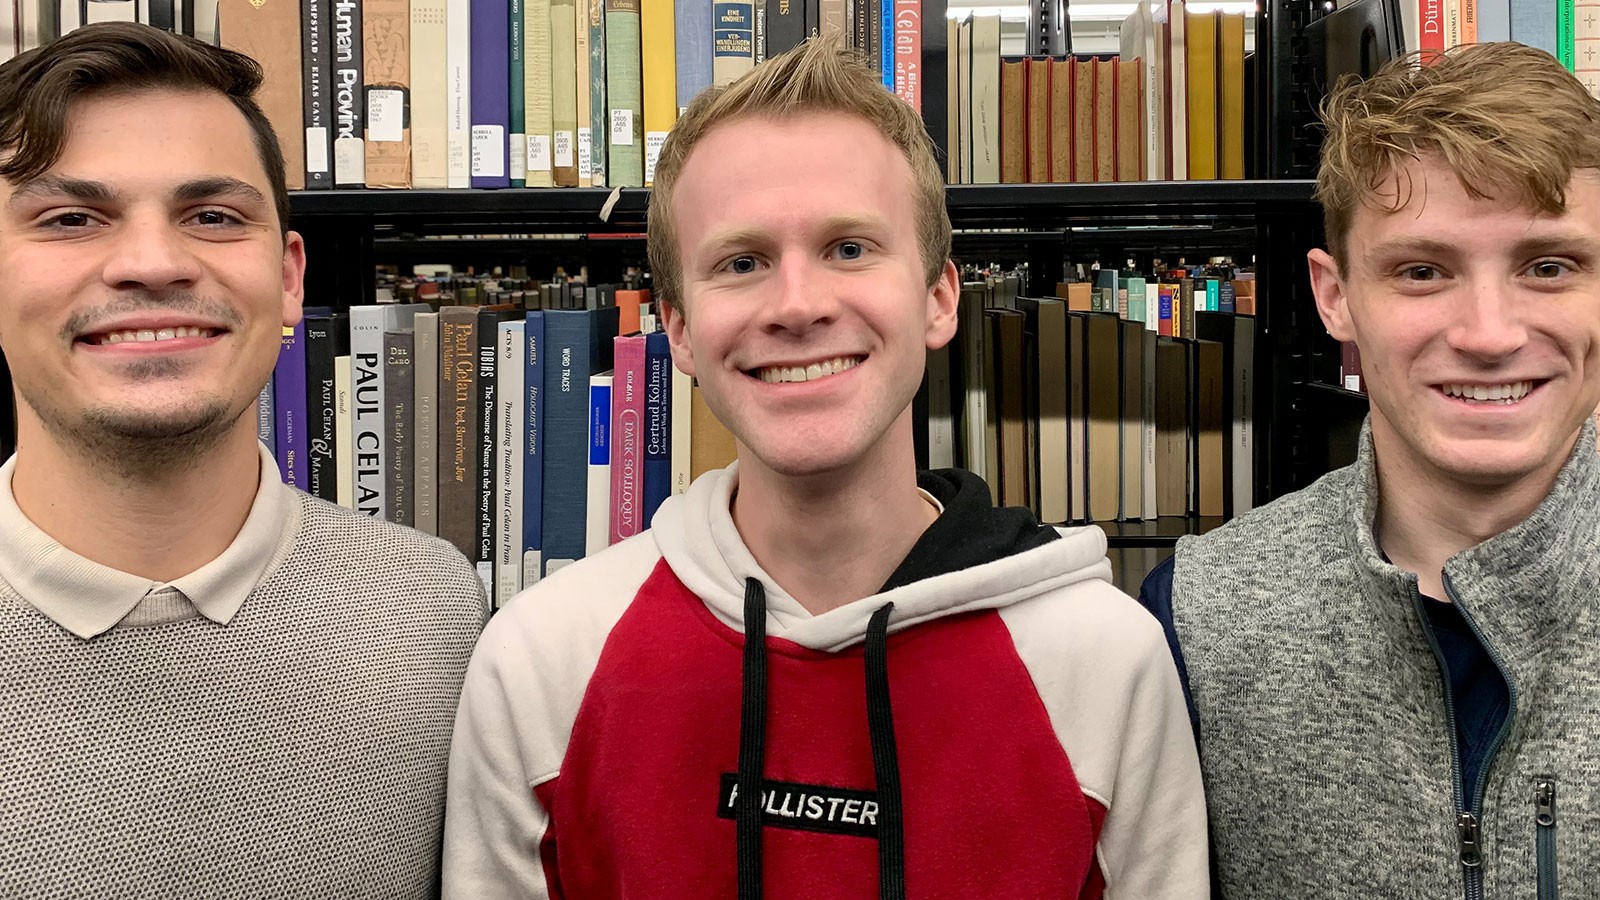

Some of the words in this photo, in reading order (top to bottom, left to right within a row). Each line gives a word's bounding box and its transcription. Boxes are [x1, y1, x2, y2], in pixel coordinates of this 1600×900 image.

[756, 9, 764, 36] Nineteen
[884, 18, 891, 27] an
[897, 9, 918, 55] Celan
[756, 36, 764, 55] Poems
[756, 55, 764, 64] by
[897, 62, 906, 75] of
[908, 62, 917, 70] A
[897, 76, 906, 95] His
[309, 329, 327, 339] Lyon
[443, 322, 453, 343] John
[456, 322, 473, 357] Paul
[388, 357, 410, 365] CARO
[390, 347, 408, 355] DEL
[480, 345, 494, 377] TOBIAS
[504, 346, 512, 359] 8/9
[561, 347, 571, 367] WORD
[356, 353, 379, 420] PAUL
[455, 360, 473, 402] Celan
[561, 368, 571, 392] TRACES
[648, 358, 660, 404] Kolmar
[660, 377, 668, 388] und
[322, 379, 333, 406] PAUL
[484, 385, 493, 400] The
[660, 388, 668, 405] Texten
[395, 402, 404, 419] The
[455, 405, 466, 425] Poet,
[529, 386, 538, 428] HOLOCAUST
[323, 407, 334, 440] CELAN
[421, 395, 429, 449] POETIC
[483, 401, 493, 434] Discourse
[503, 401, 512, 447] Translating
[660, 412, 668, 426] Werk
[394, 422, 404, 442] Early
[483, 434, 493, 443] of
[623, 421, 634, 457] DARK
[647, 406, 660, 455] Gertrud
[660, 426, 668, 438] und
[455, 426, 466, 465] Survivor,
[660, 437, 668, 454] Leben
[394, 446, 404, 471] Poetry
[482, 444, 492, 468] Nature
[288, 470, 296, 481] of
[311, 457, 321, 497] MARTIN
[454, 465, 466, 482] Jew
[482, 469, 492, 477] in
[503, 448, 512, 487] Tradition:
[395, 474, 404, 483] of
[482, 478, 491, 489] the
[395, 486, 404, 507] PAUL
[480, 490, 491, 513] Poetry
[503, 488, 512, 508] Paul
[621, 458, 634, 529] SOLILOQUY
[481, 513, 491, 522] of
[503, 509, 512, 532] Celan
[481, 522, 491, 538] Paul
[503, 534, 511, 543] in
[481, 538, 492, 559] Celan
[728, 783, 879, 826] LLISTER
